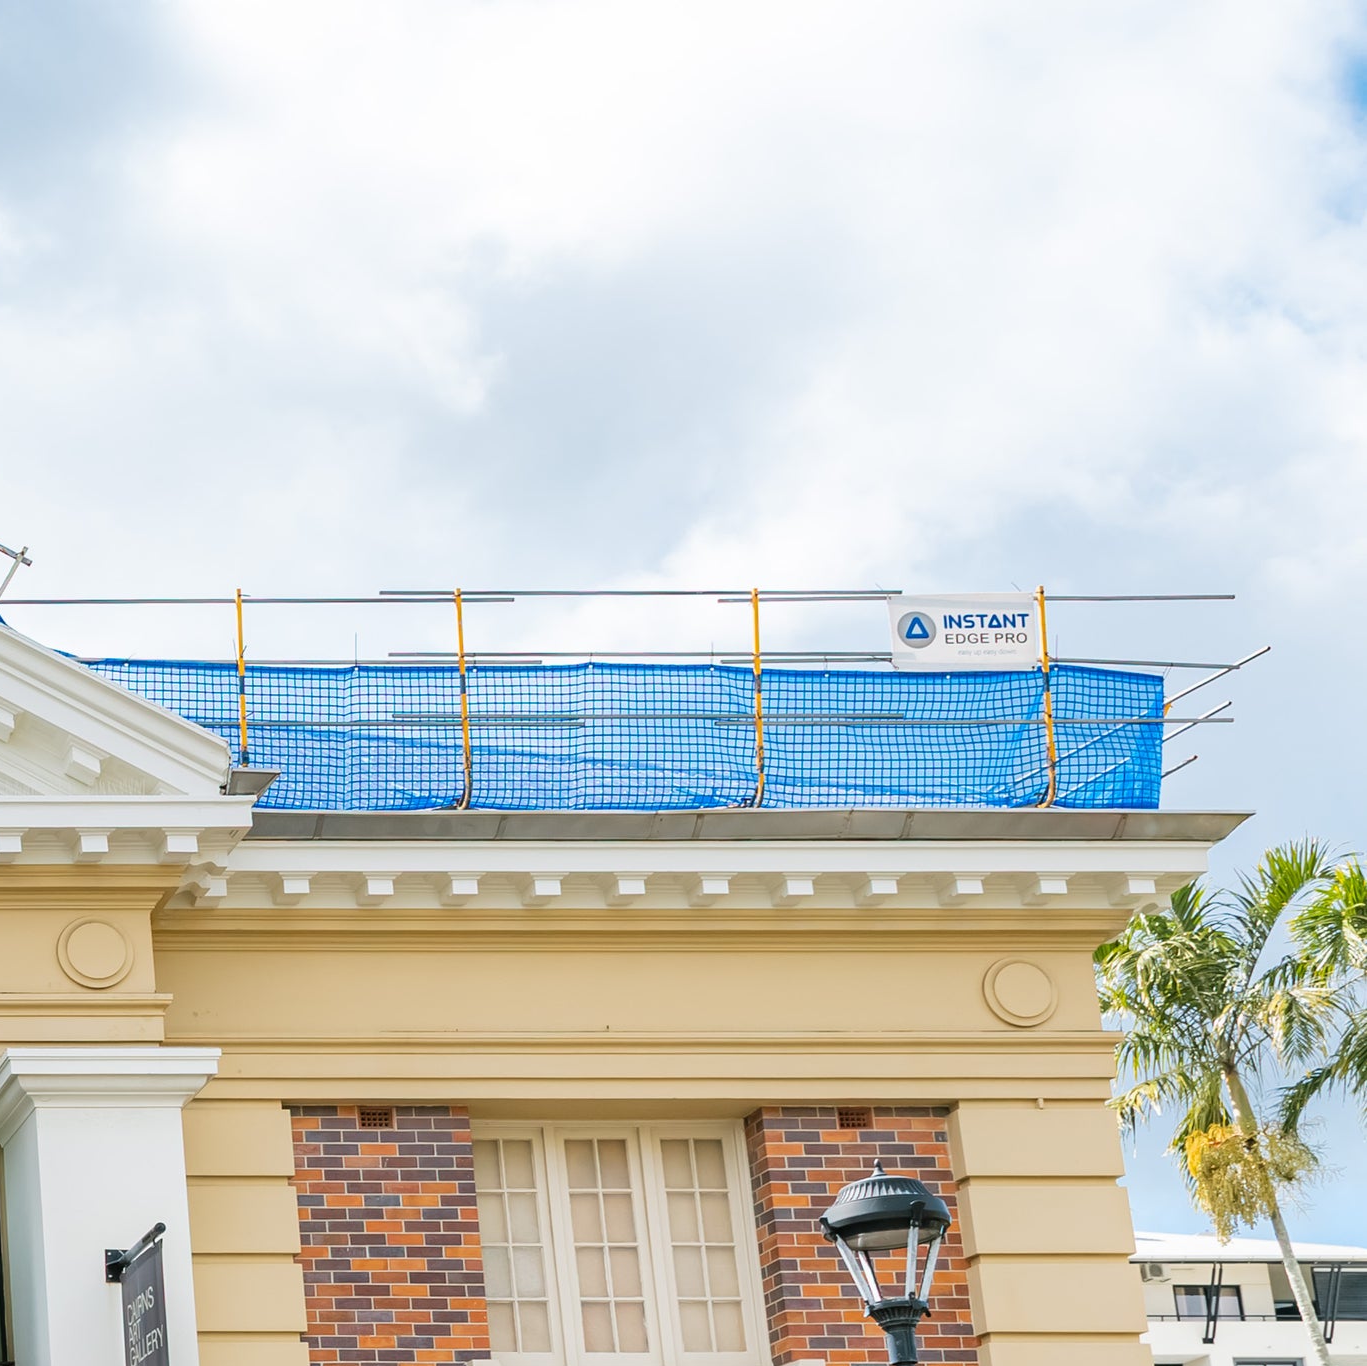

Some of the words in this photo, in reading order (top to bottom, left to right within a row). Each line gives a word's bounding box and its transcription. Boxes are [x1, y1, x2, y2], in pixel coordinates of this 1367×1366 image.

[943, 613, 1029, 629] INSTANT
[945, 633, 990, 644] EDGE
[994, 632, 1028, 644] PRO
[127, 1286, 155, 1326] CAIRNS
[128, 1318, 141, 1347] ART
